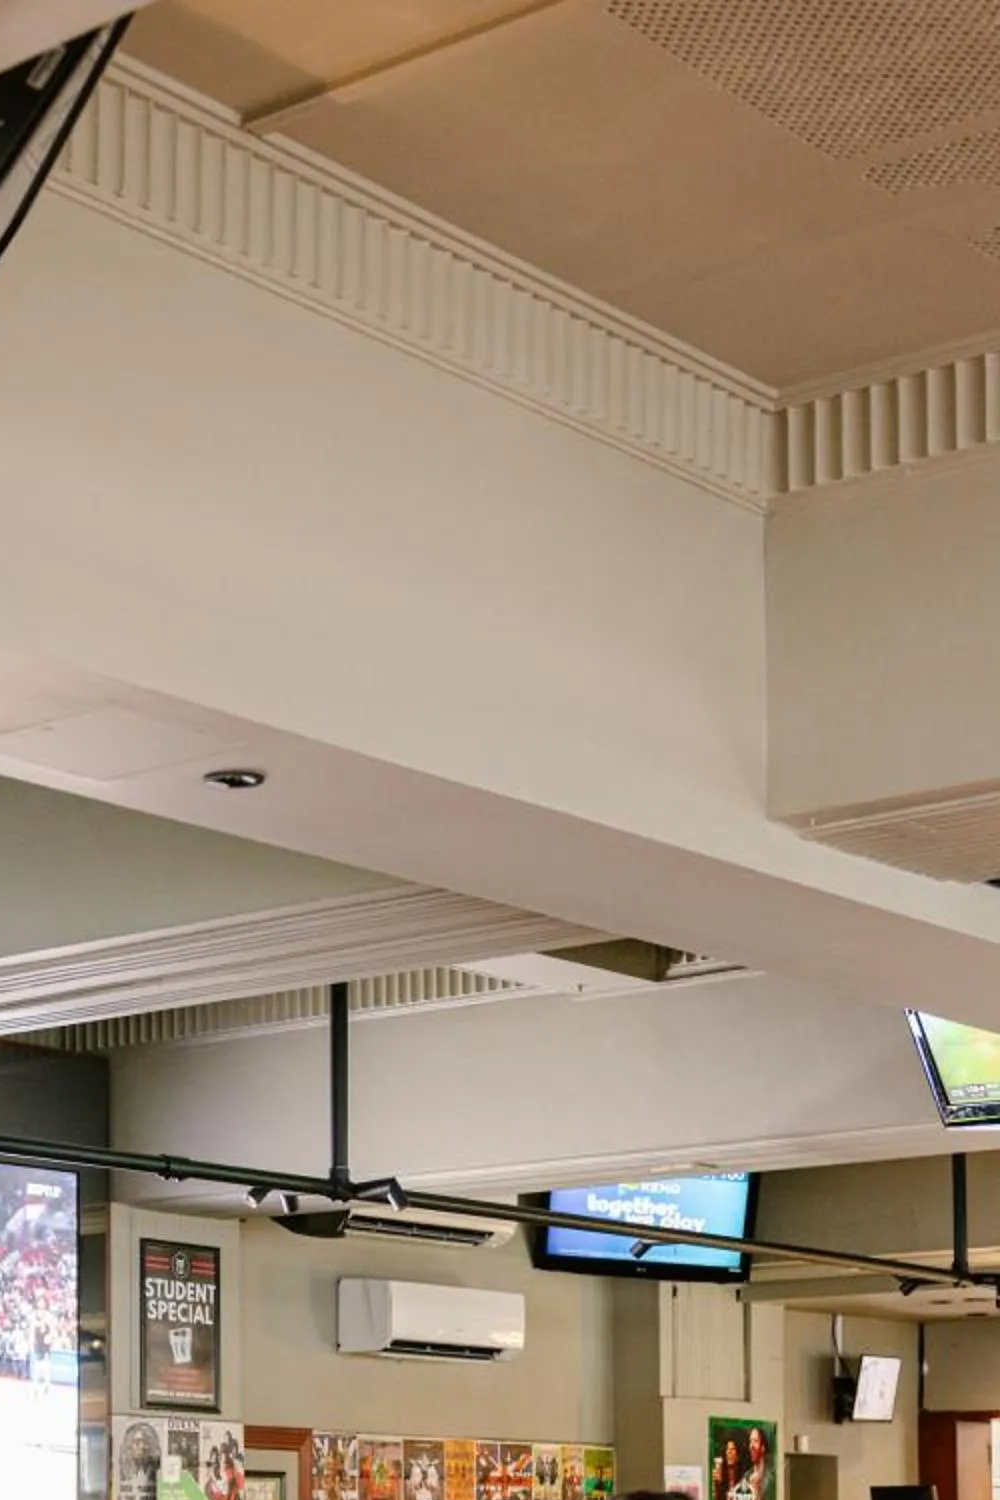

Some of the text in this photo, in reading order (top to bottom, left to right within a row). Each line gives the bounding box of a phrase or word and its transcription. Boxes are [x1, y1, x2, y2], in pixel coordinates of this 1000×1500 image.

[587, 1193, 680, 1218] together
[145, 1277, 217, 1305] STUDENT
[147, 1300, 215, 1326] SPECIAL
